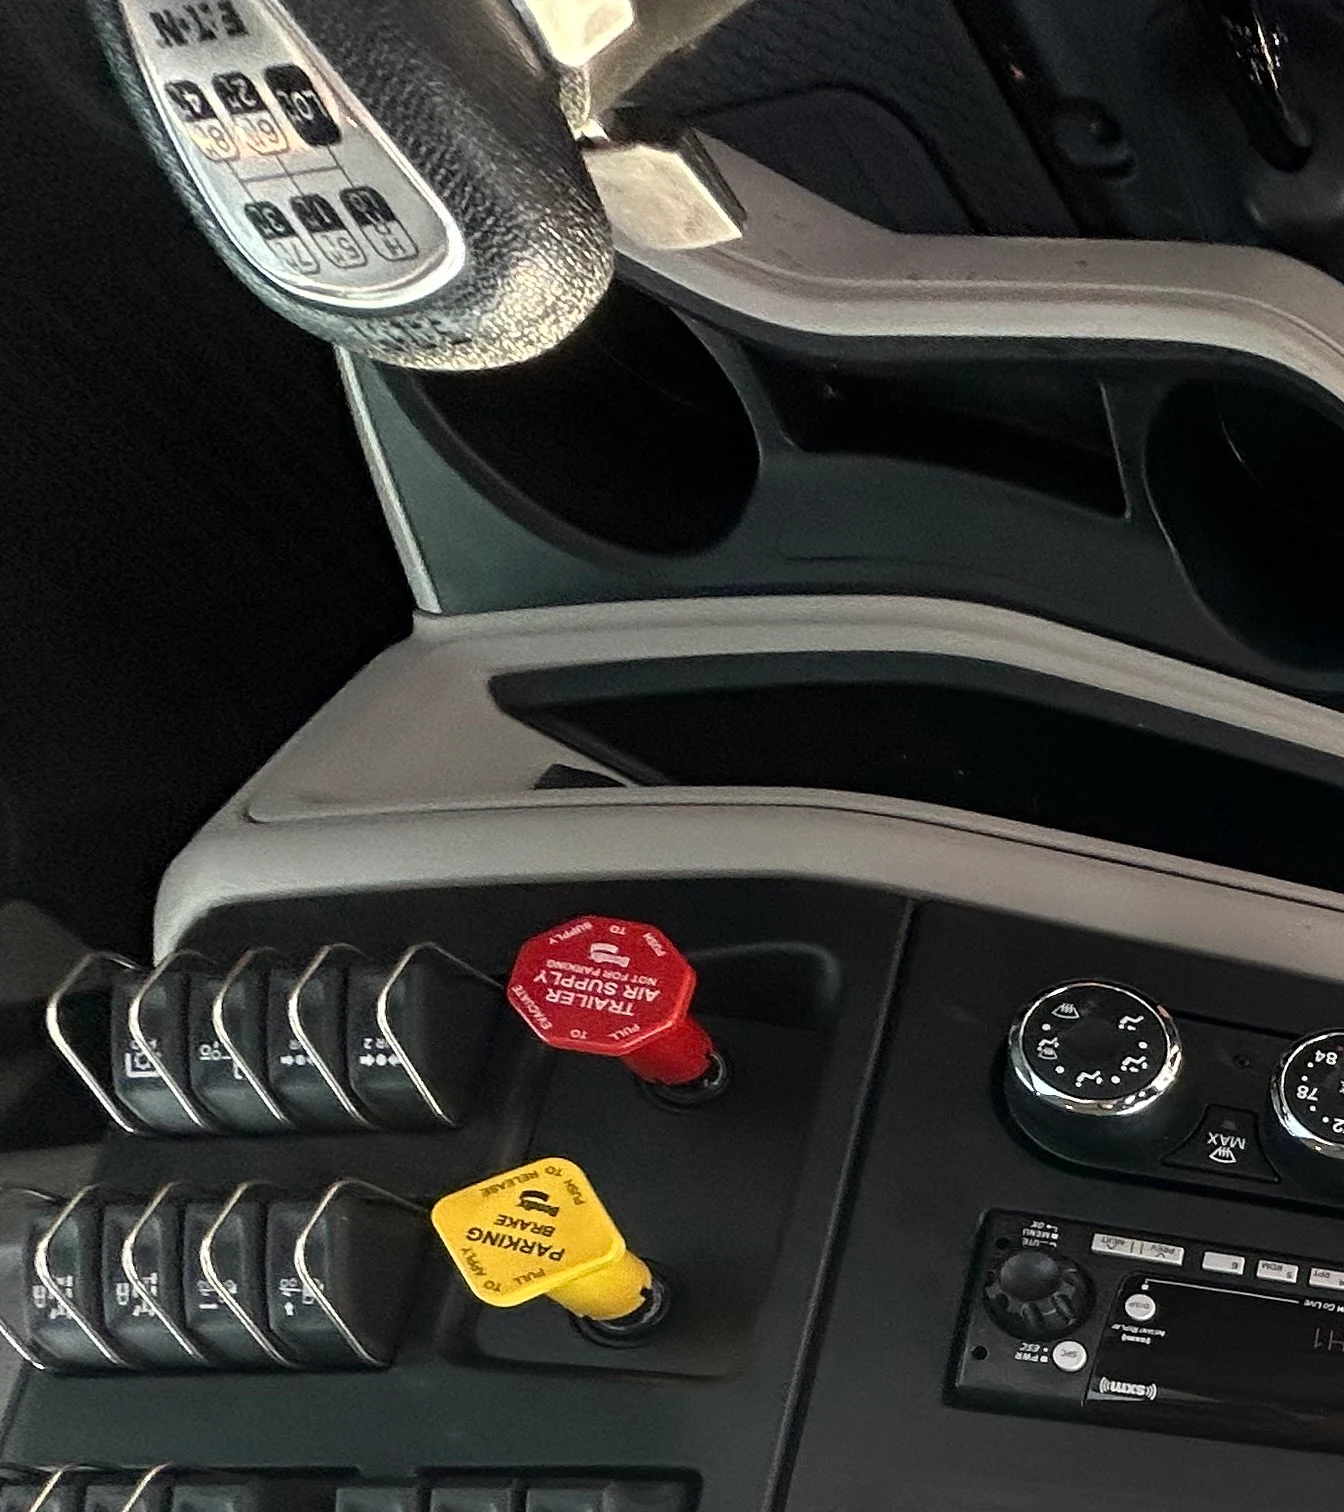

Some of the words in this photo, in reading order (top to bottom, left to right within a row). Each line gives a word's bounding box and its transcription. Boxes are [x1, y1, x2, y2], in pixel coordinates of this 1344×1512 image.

[233, 77, 258, 108] 2
[181, 92, 202, 117] 4
[207, 126, 230, 152] 8
[257, 119, 279, 144] 6
[261, 207, 285, 232] 3
[547, 920, 594, 945] SUPPLY
[608, 924, 626, 936] TO
[545, 958, 601, 978] PARKING
[602, 968, 630, 981] FOR
[532, 969, 618, 996] SUPPLY
[631, 974, 658, 986] NOT
[544, 987, 635, 1017] TRAILER
[622, 984, 660, 1002] AIR
[510, 983, 553, 1030] EVACUATE
[569, 1028, 588, 1040] TO
[607, 1022, 641, 1041] PULL
[363, 1038, 373, 1049] 2
[1315, 1049, 1338, 1065] 84
[1296, 1084, 1319, 1101] 78
[1207, 1132, 1246, 1149] MAX
[544, 1165, 563, 1177] TO
[479, 1170, 540, 1198] RELEASE
[563, 1178, 585, 1206] PUSH
[493, 1214, 556, 1237] BRAKE
[465, 1227, 566, 1262] PARKING
[460, 1246, 487, 1276] APPLY
[483, 1279, 503, 1292] TO
[512, 1267, 546, 1285] PULL
[1019, 1342, 1040, 1352] ESC
[1014, 1351, 1039, 1363] PWR
